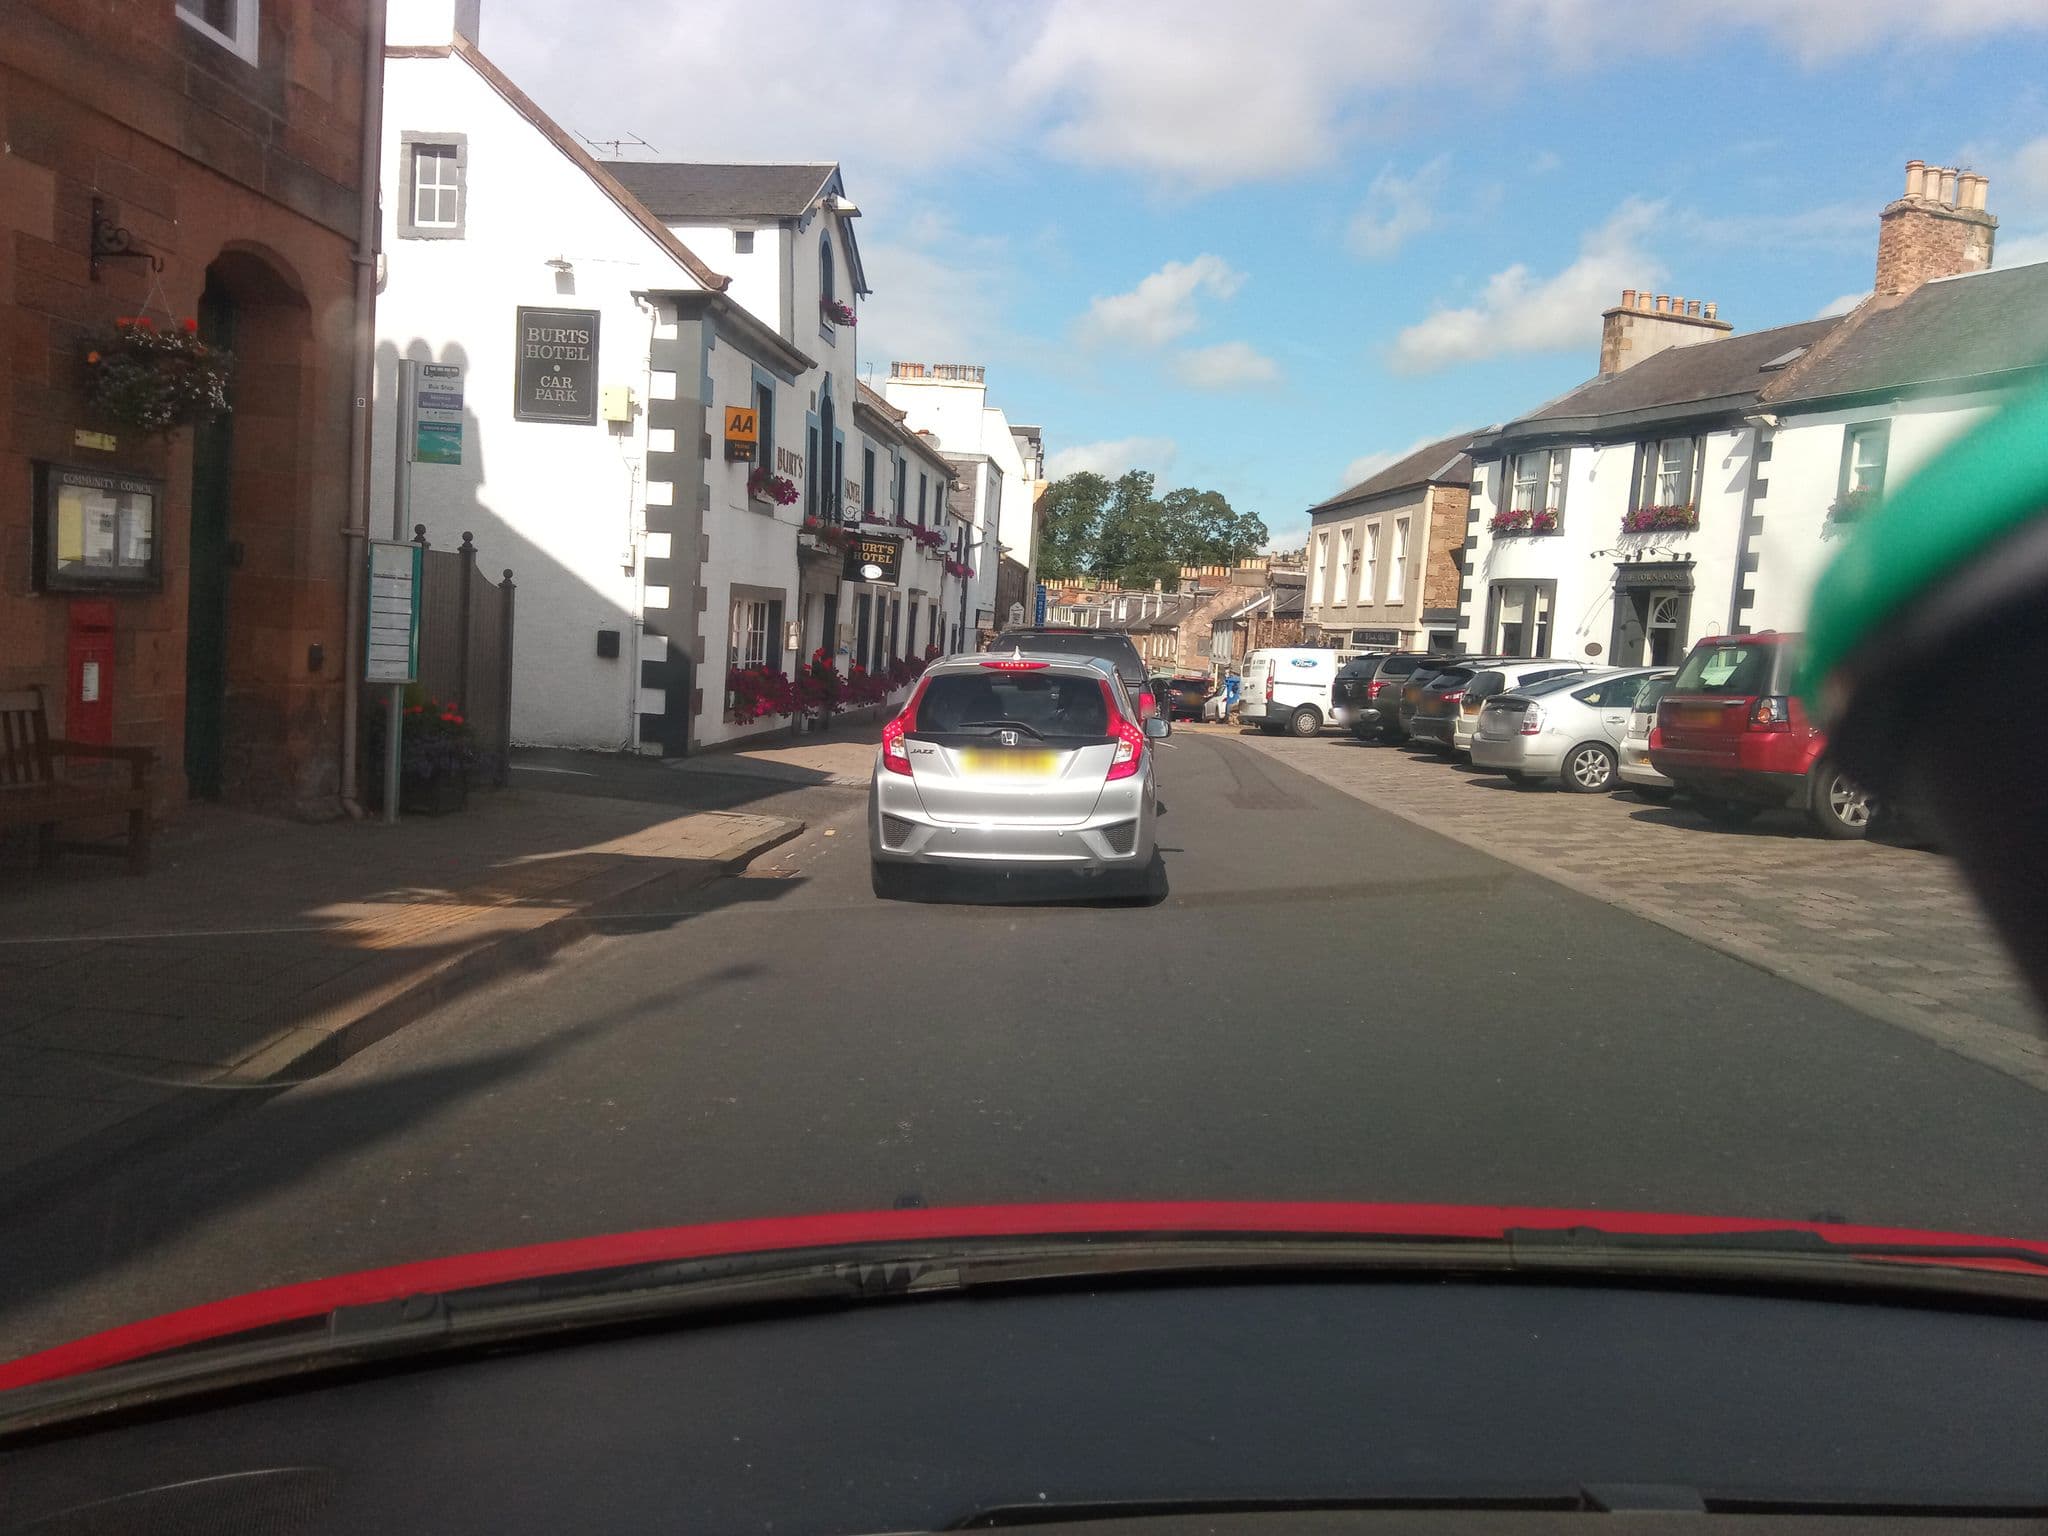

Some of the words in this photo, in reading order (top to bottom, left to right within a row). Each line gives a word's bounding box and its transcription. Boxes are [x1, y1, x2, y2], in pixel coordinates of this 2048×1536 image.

[527, 327, 589, 345] BURTS
[526, 344, 590, 361] HOTEL
[540, 375, 573, 388] CAR
[535, 388, 578, 402] PARK
[730, 414, 753, 433] AA
[777, 446, 803, 479] BURT'S
[63, 472, 114, 489] COMMUNITY
[120, 480, 153, 494] COUNCIL
[853, 551, 893, 564] HOTEL
